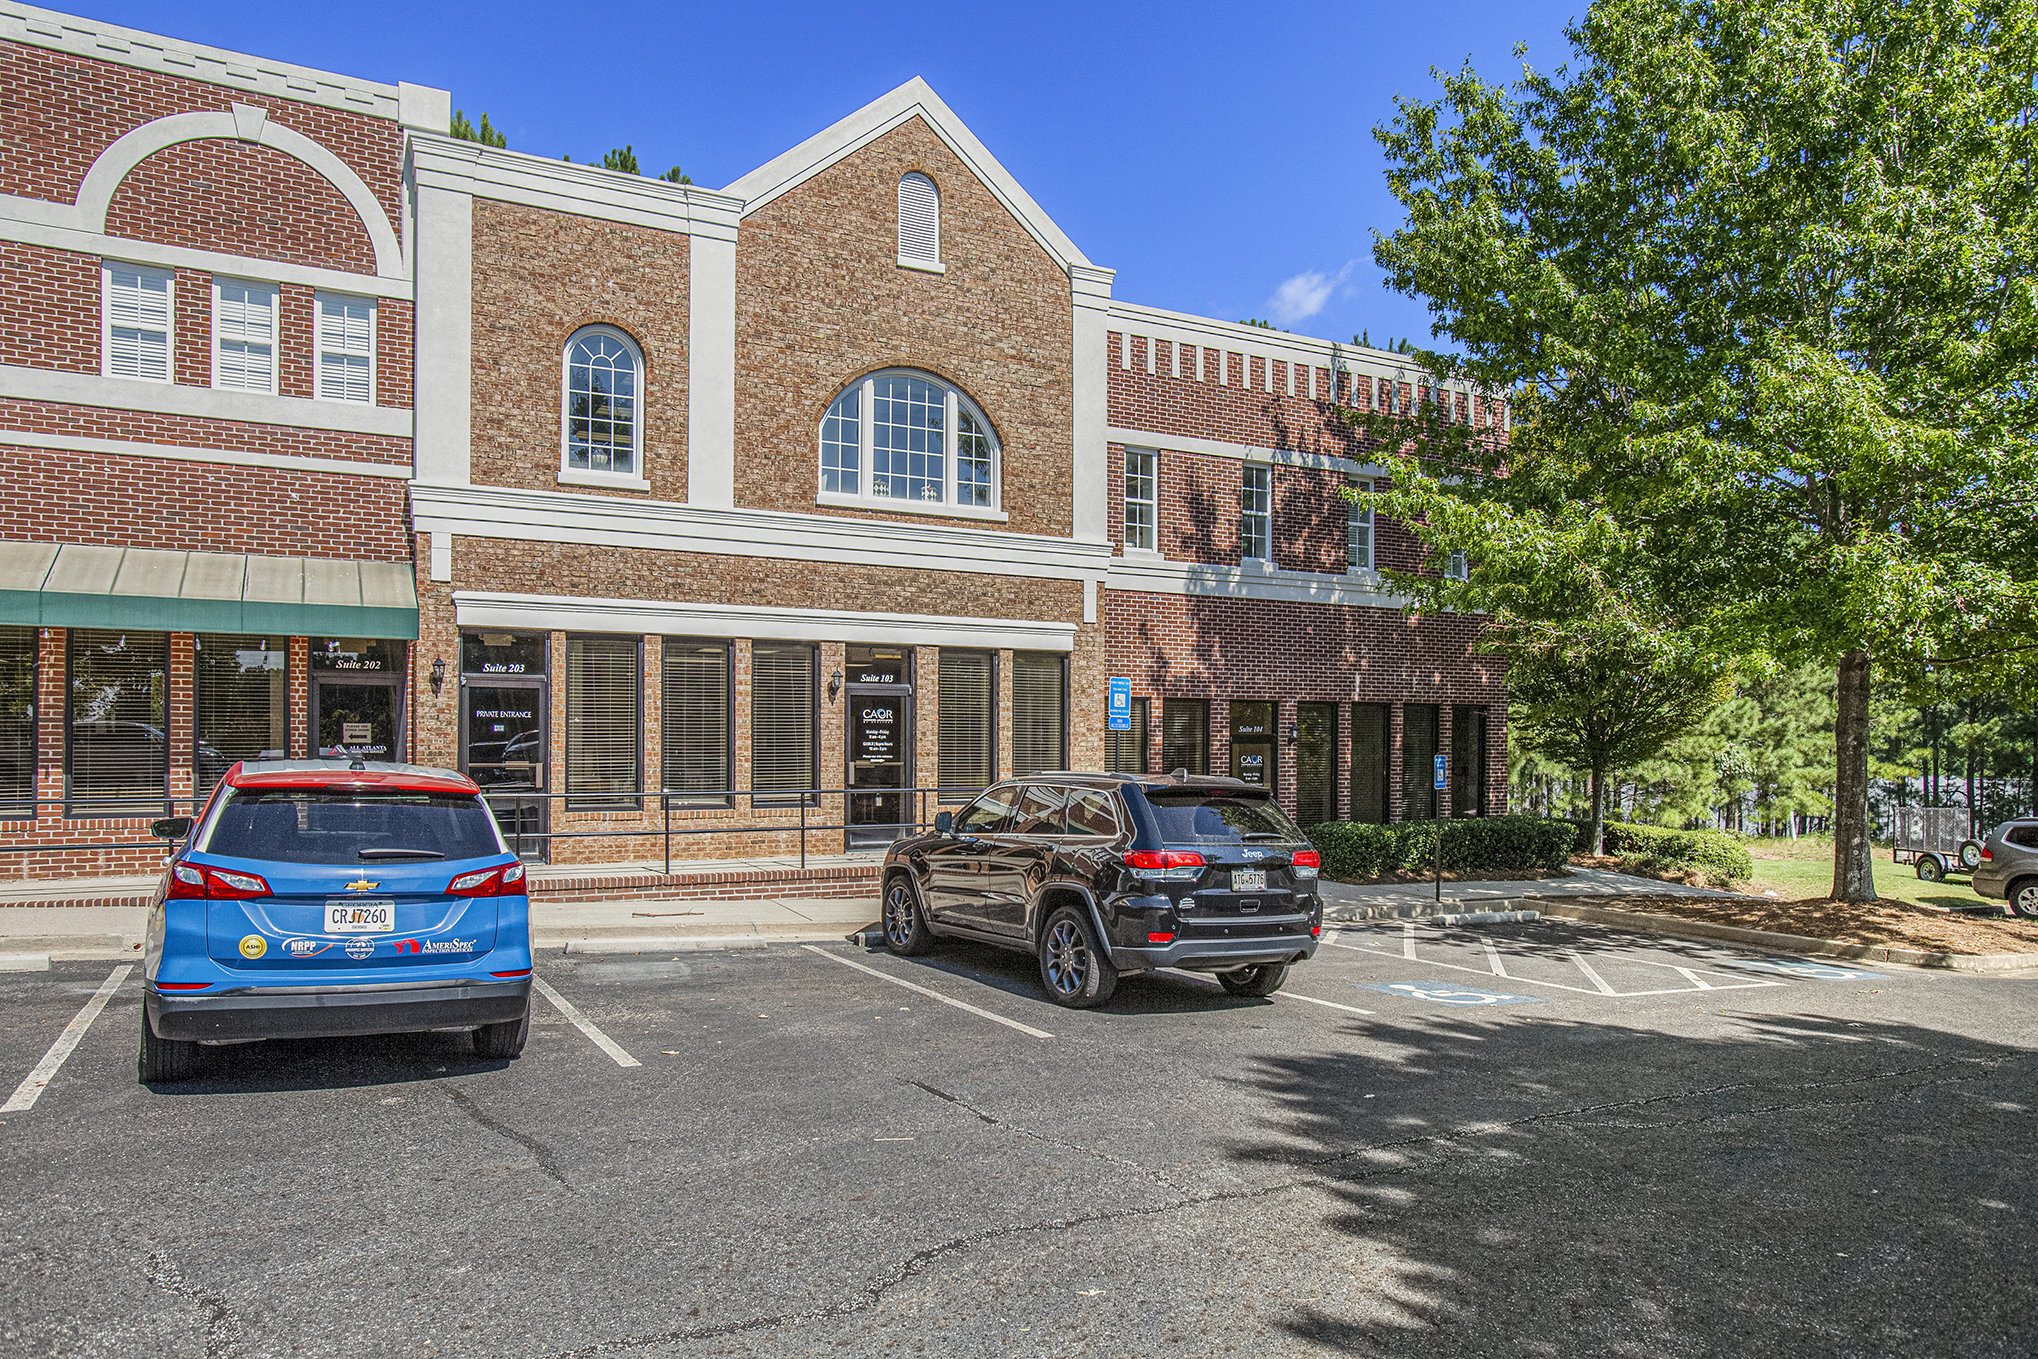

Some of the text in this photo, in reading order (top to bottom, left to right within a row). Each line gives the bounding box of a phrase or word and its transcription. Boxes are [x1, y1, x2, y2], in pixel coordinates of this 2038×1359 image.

[335, 660, 381, 670] Suite 202
[482, 663, 525, 673] Suite 203
[860, 674, 894, 683] Suite 103
[475, 710, 532, 719] PRIVATE ENTRANCE
[1241, 848, 1264, 859] Jeep
[332, 909, 387, 924] CRJ7260
[290, 941, 317, 951] NRPP
